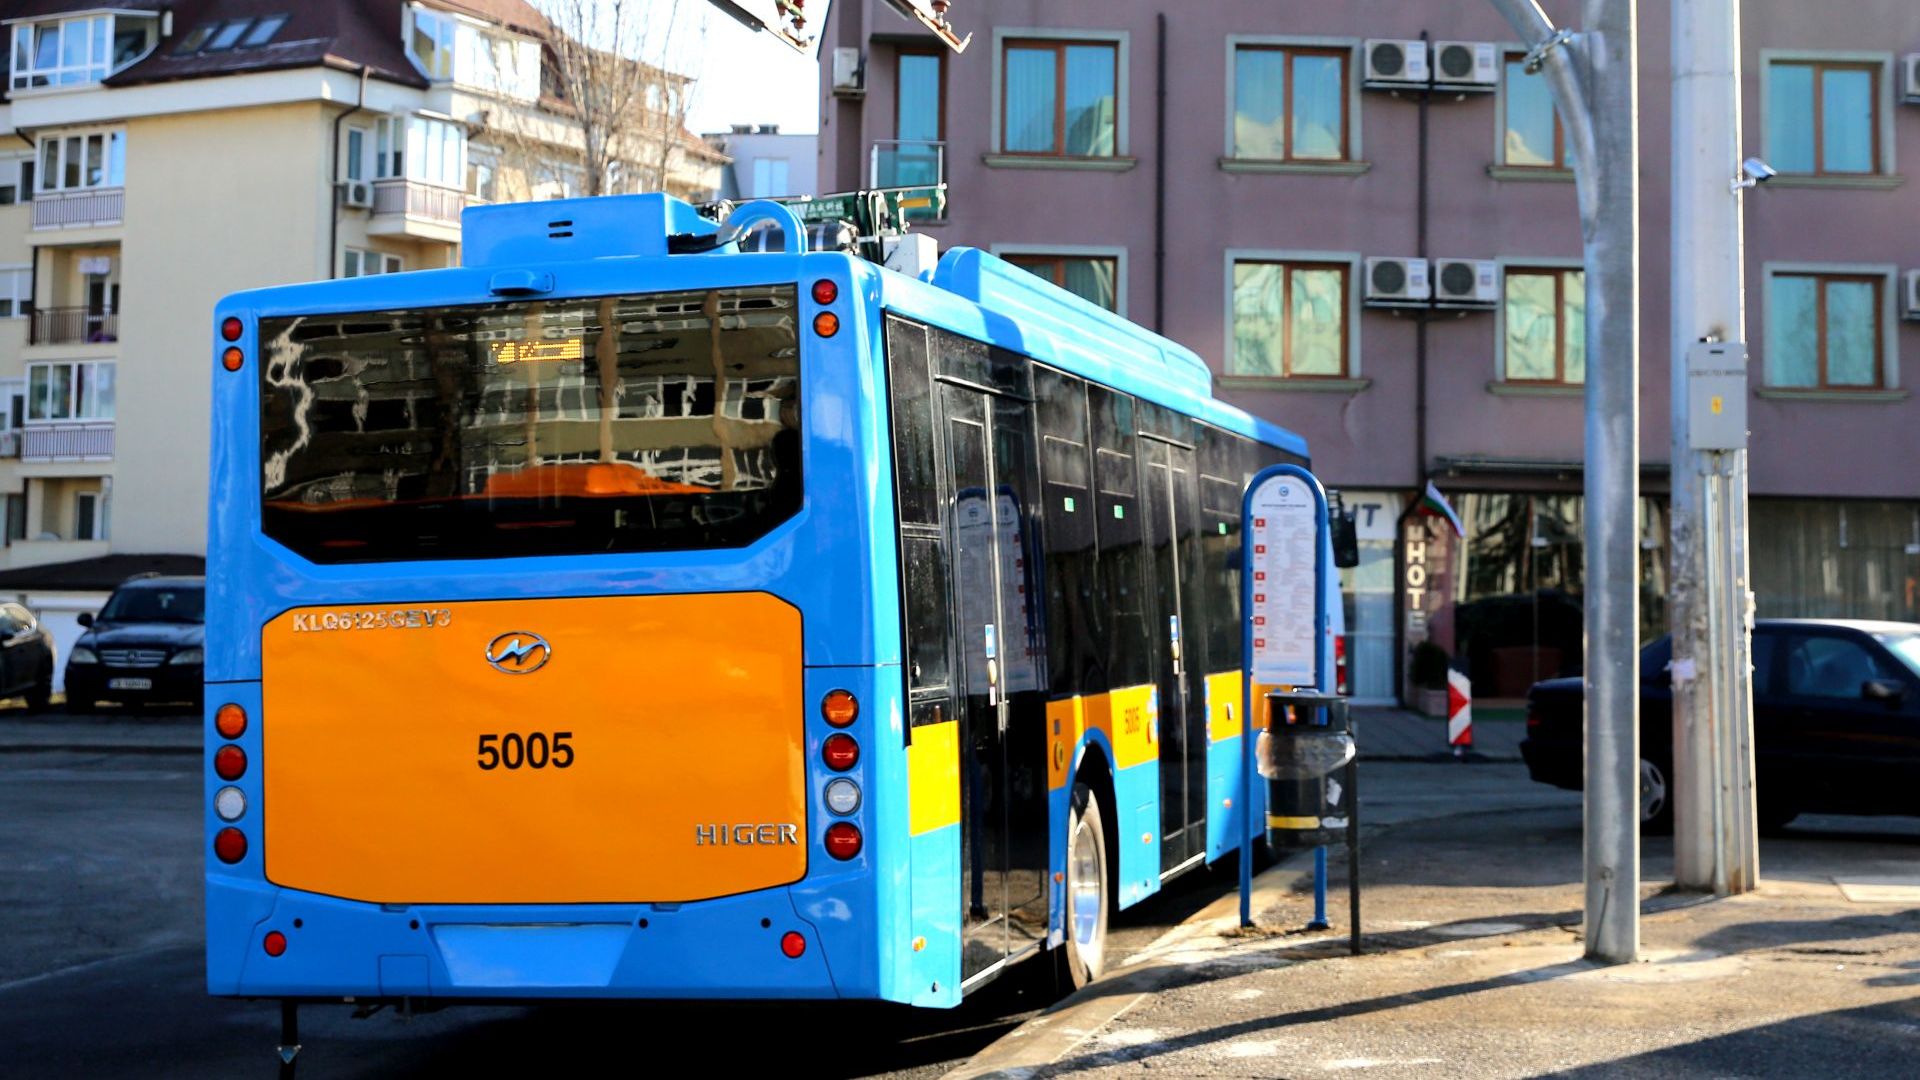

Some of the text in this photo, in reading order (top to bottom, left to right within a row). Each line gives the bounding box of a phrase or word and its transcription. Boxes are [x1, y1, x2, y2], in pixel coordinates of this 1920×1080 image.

[293, 608, 451, 632] KLQ6125GEV3
[477, 731, 574, 771] 5005
[696, 823, 798, 845] HIGER
